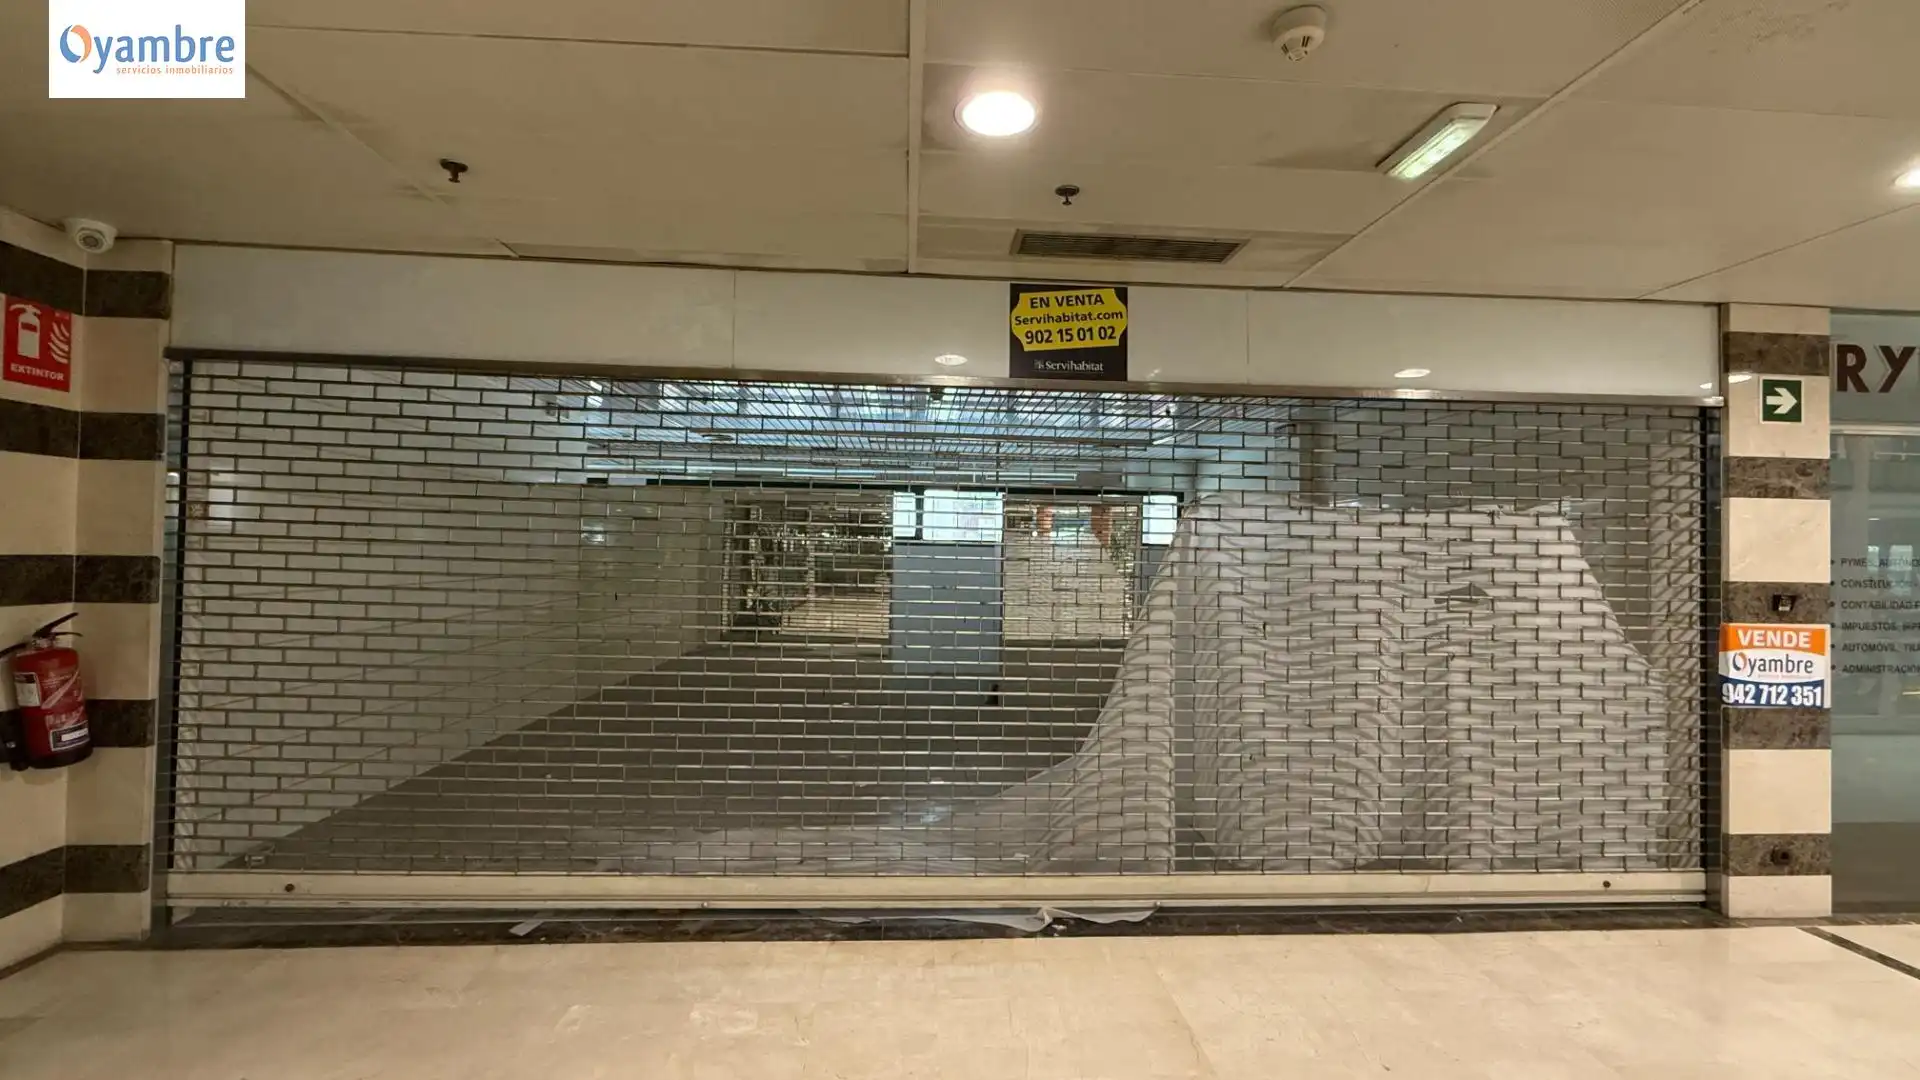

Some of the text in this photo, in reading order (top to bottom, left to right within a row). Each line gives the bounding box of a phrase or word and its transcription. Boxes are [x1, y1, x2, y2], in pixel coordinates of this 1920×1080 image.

[1029, 293, 1105, 309] EN VENTA
[1014, 310, 1123, 326] Servihabitat.com
[1024, 325, 1116, 344] 902 15 01 02
[10, 362, 64, 381] EXTINTOR
[1045, 360, 1104, 371] Servihabitat
[1737, 629, 1811, 649] VENDE
[1732, 652, 1814, 677] Oyambre
[1722, 682, 1822, 707] 942 712 351
